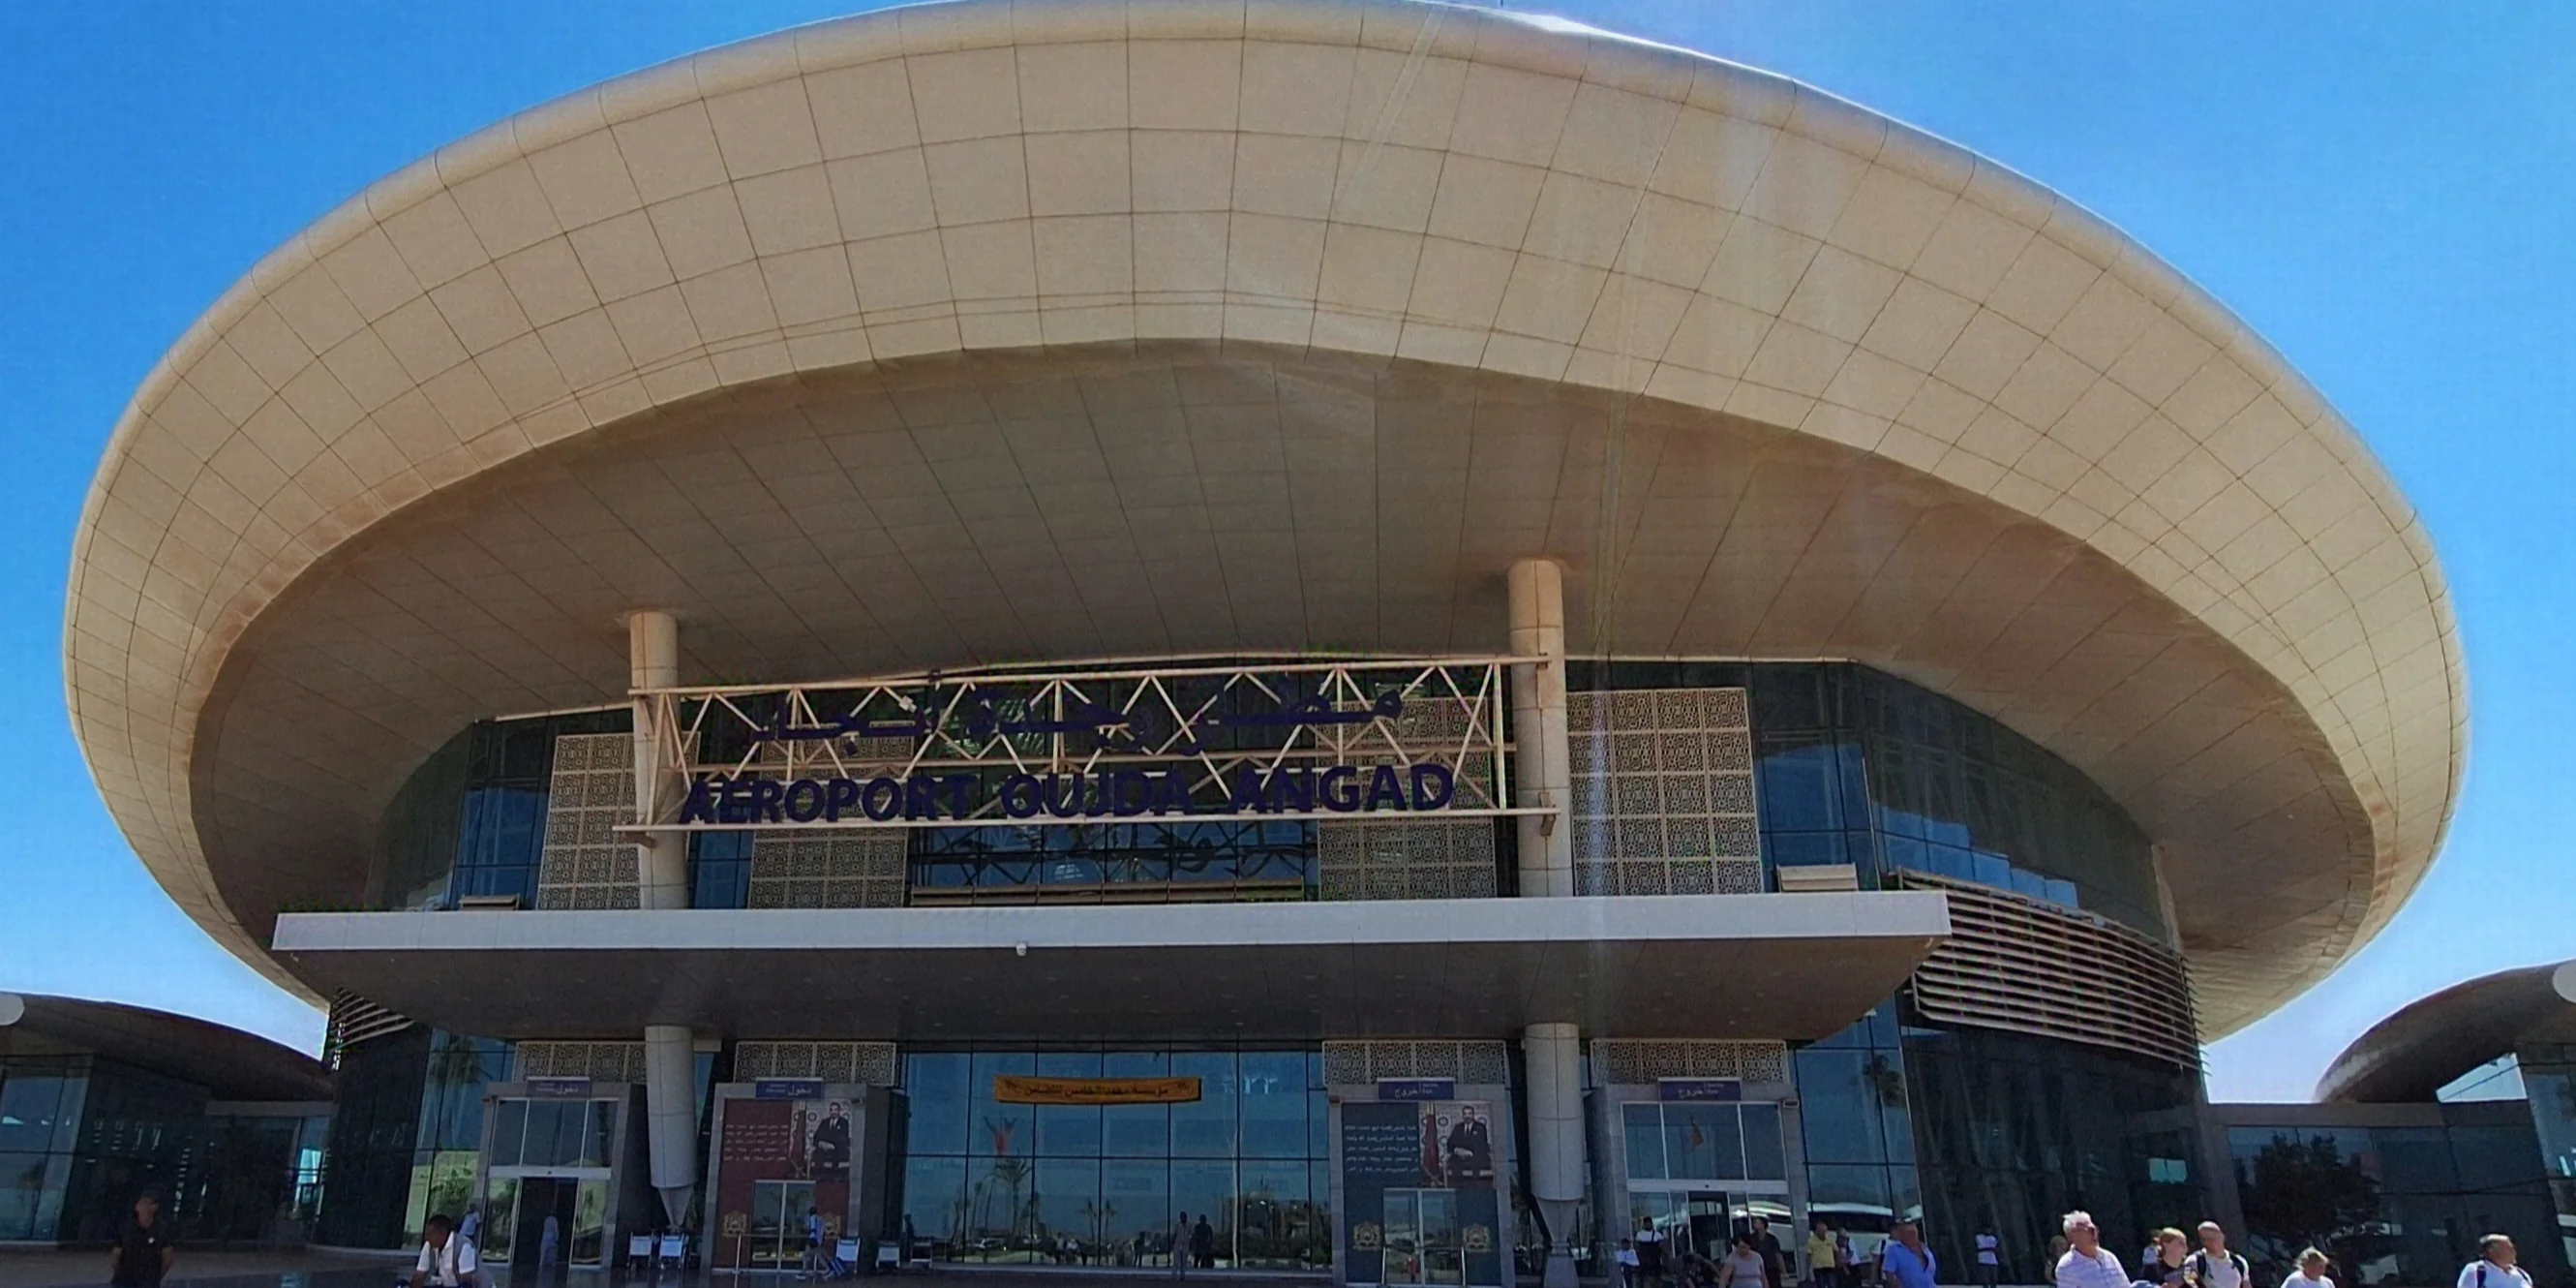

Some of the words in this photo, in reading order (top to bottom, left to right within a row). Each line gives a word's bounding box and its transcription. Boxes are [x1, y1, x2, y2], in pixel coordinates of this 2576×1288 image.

[1181, 675, 1403, 756] مطار
[679, 774, 980, 823] AEROPORT
[1001, 768, 1194, 820] OUJDA
[1227, 763, 1455, 814] ANGAD
